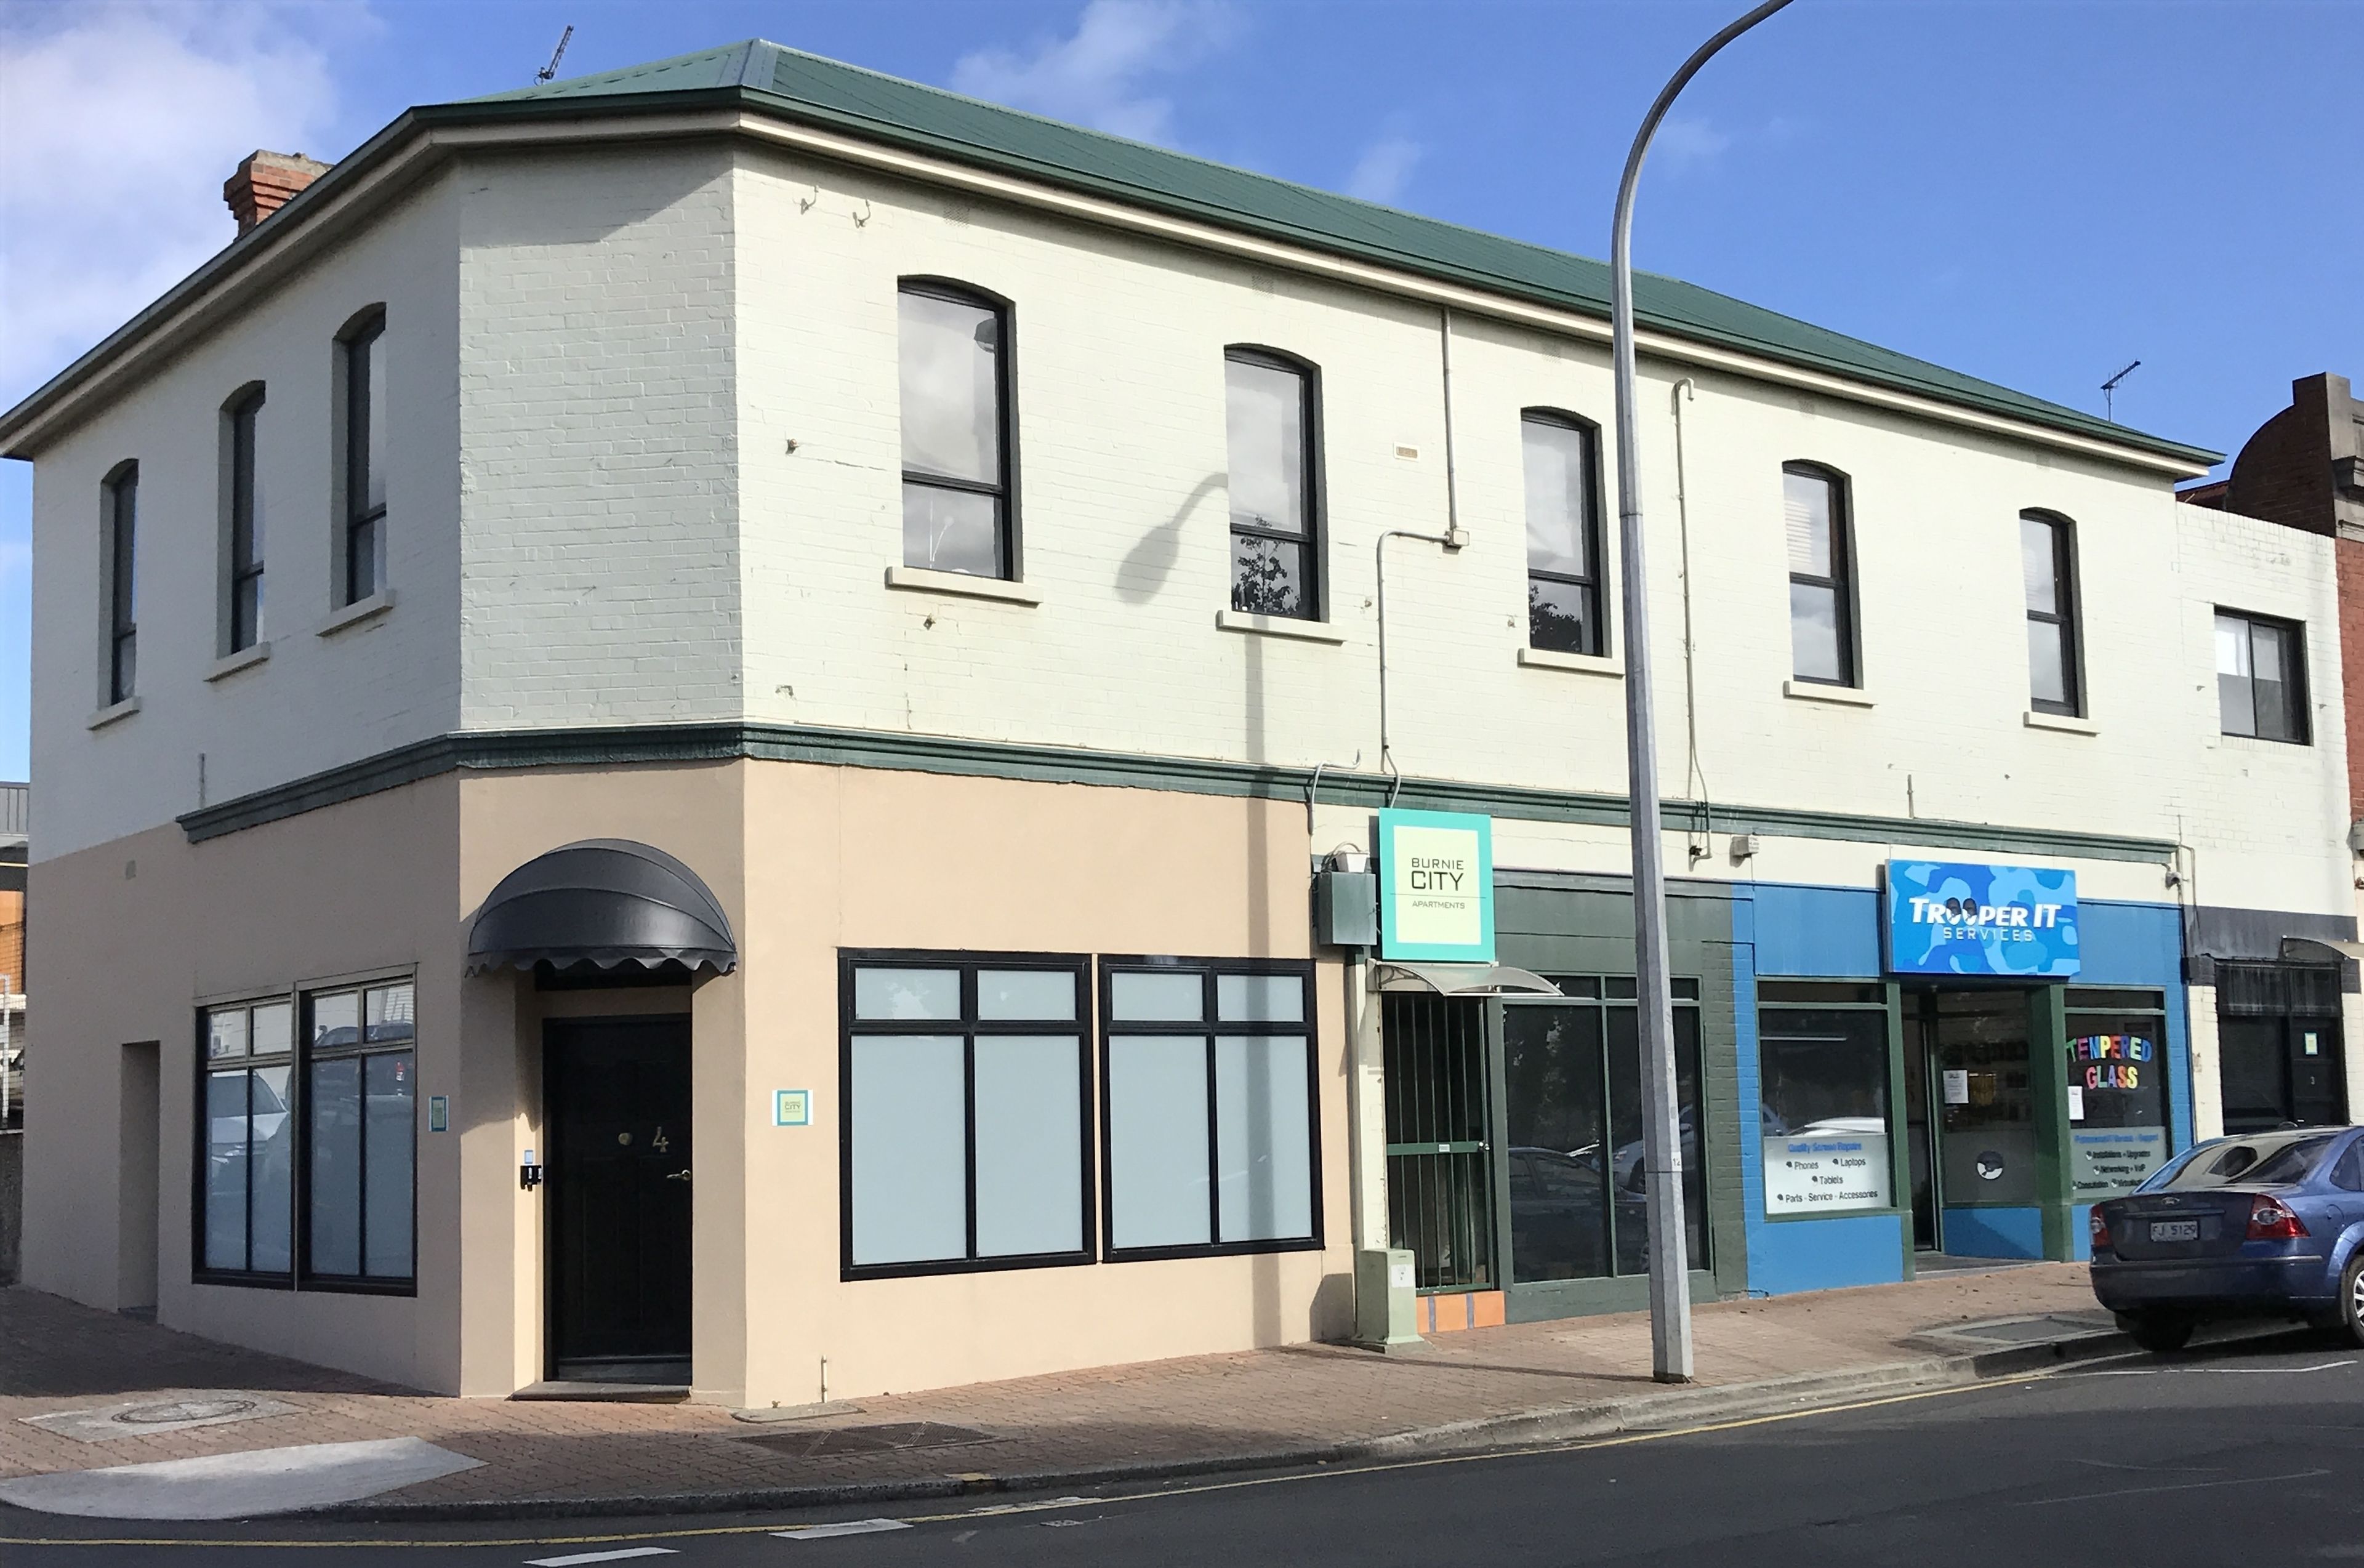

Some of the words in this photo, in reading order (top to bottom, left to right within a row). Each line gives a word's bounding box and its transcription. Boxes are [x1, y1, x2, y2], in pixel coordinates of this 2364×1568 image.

[1412, 857, 1464, 870] BURNIE
[1411, 870, 1464, 891] CITY
[1412, 900, 1465, 909] APARTMENTS
[2033, 904, 2062, 928] IT
[1943, 926, 2033, 942] SERVICES
[2086, 1064, 2139, 1090] GLASS
[652, 1126, 669, 1153] 4
[1794, 1161, 1819, 1170] Phones
[1840, 1158, 1866, 1168] Laptops
[1819, 1176, 1844, 1184] Tablets
[1785, 1194, 1803, 1203] Parts
[1808, 1192, 1833, 1202] Service
[1838, 1190, 1878, 1200] Accessories
